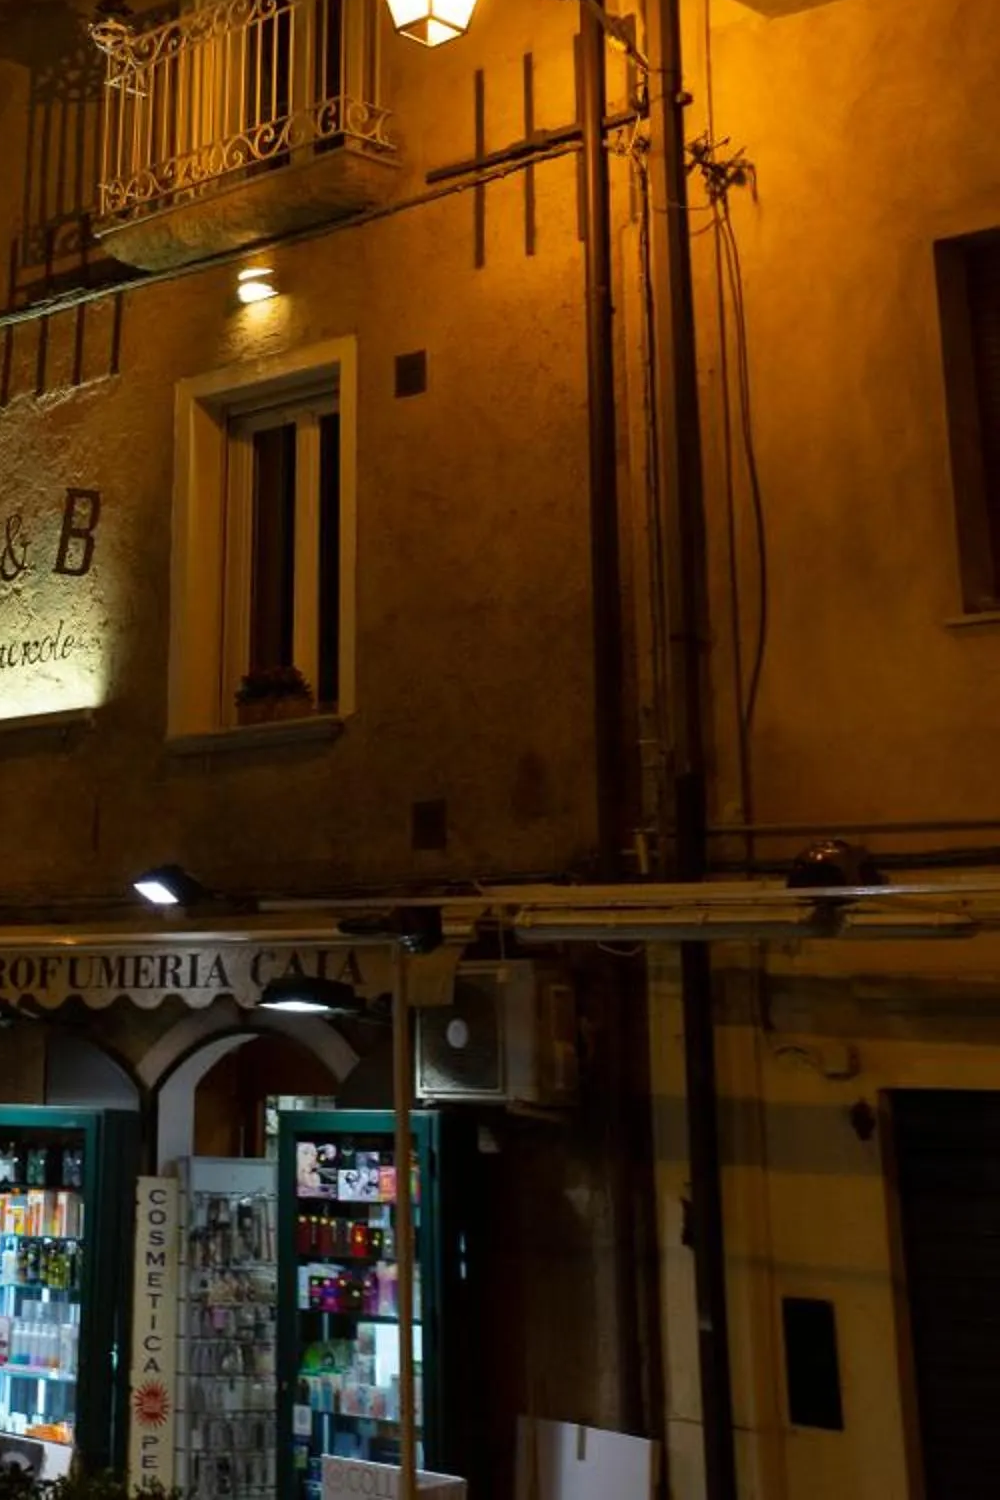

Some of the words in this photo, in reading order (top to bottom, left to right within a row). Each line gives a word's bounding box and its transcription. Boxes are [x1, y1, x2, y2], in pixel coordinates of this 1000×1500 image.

[0, 513, 34, 582] &
[52, 487, 100, 576] B
[143, 1189, 167, 1374] COSMETICA
